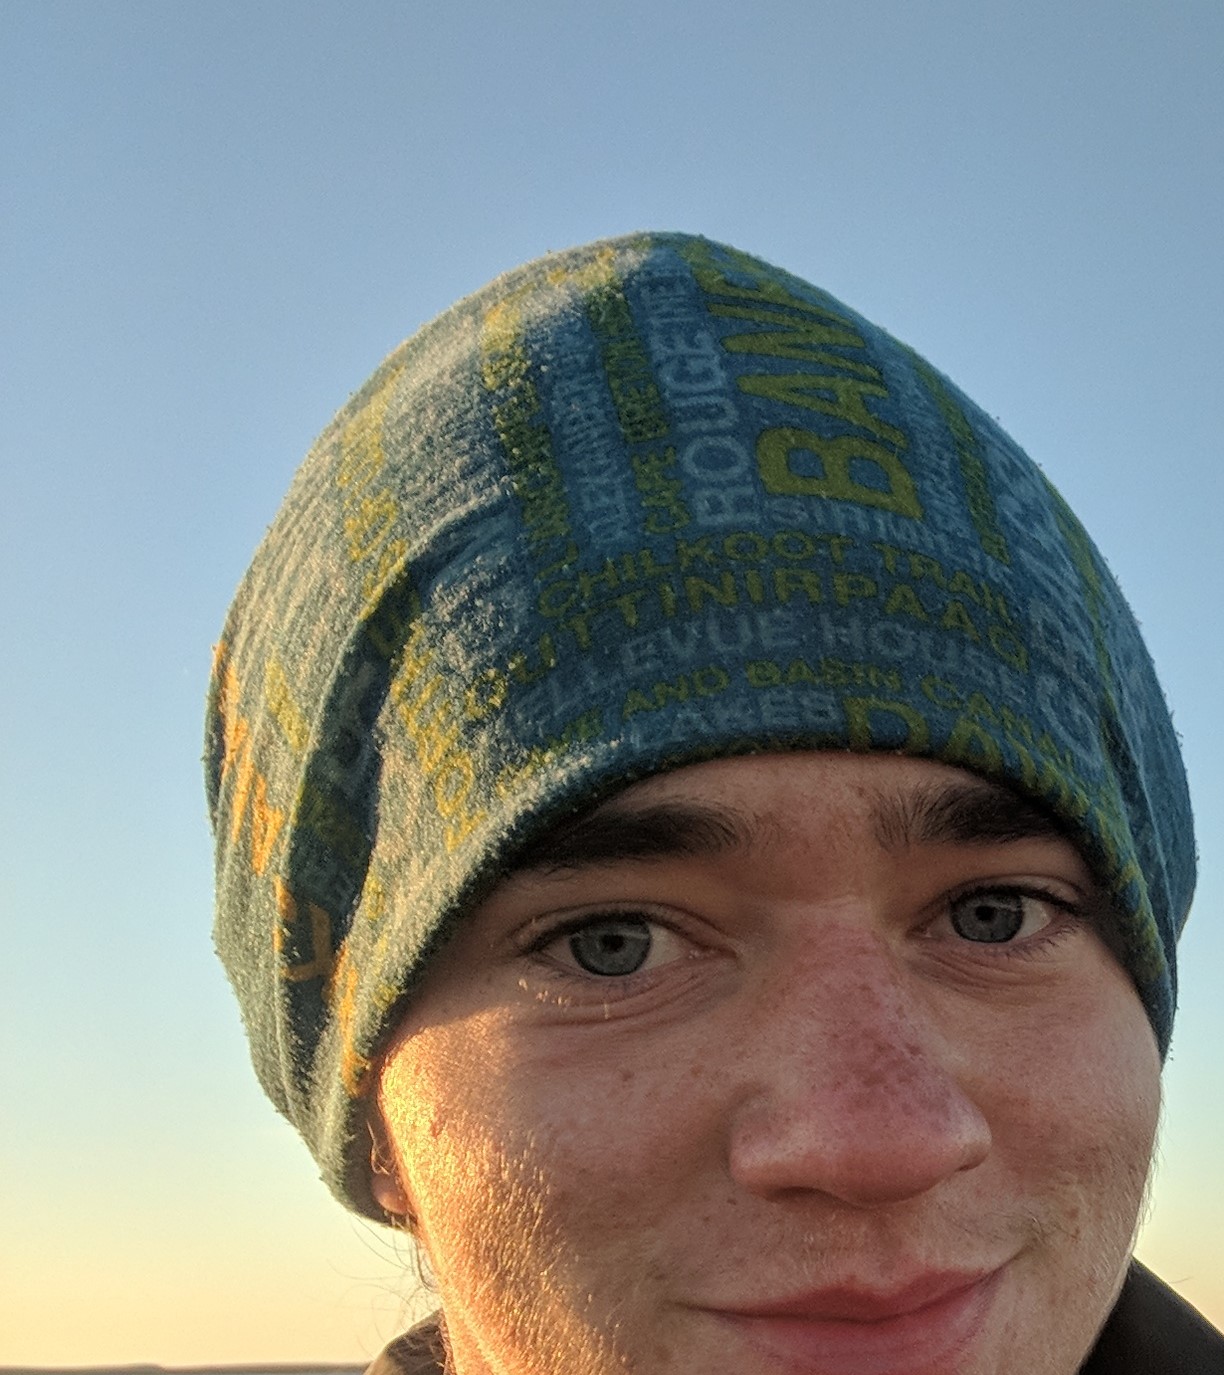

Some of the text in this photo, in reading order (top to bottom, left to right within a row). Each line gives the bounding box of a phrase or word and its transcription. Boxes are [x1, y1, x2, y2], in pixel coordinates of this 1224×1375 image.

[653, 329, 764, 526] ROUGE
[538, 530, 1010, 618] CHILKOOT TRAIL
[492, 609, 806, 750] ELLEVUE
[622, 662, 729, 719] AND
[746, 659, 899, 692] BASIN
